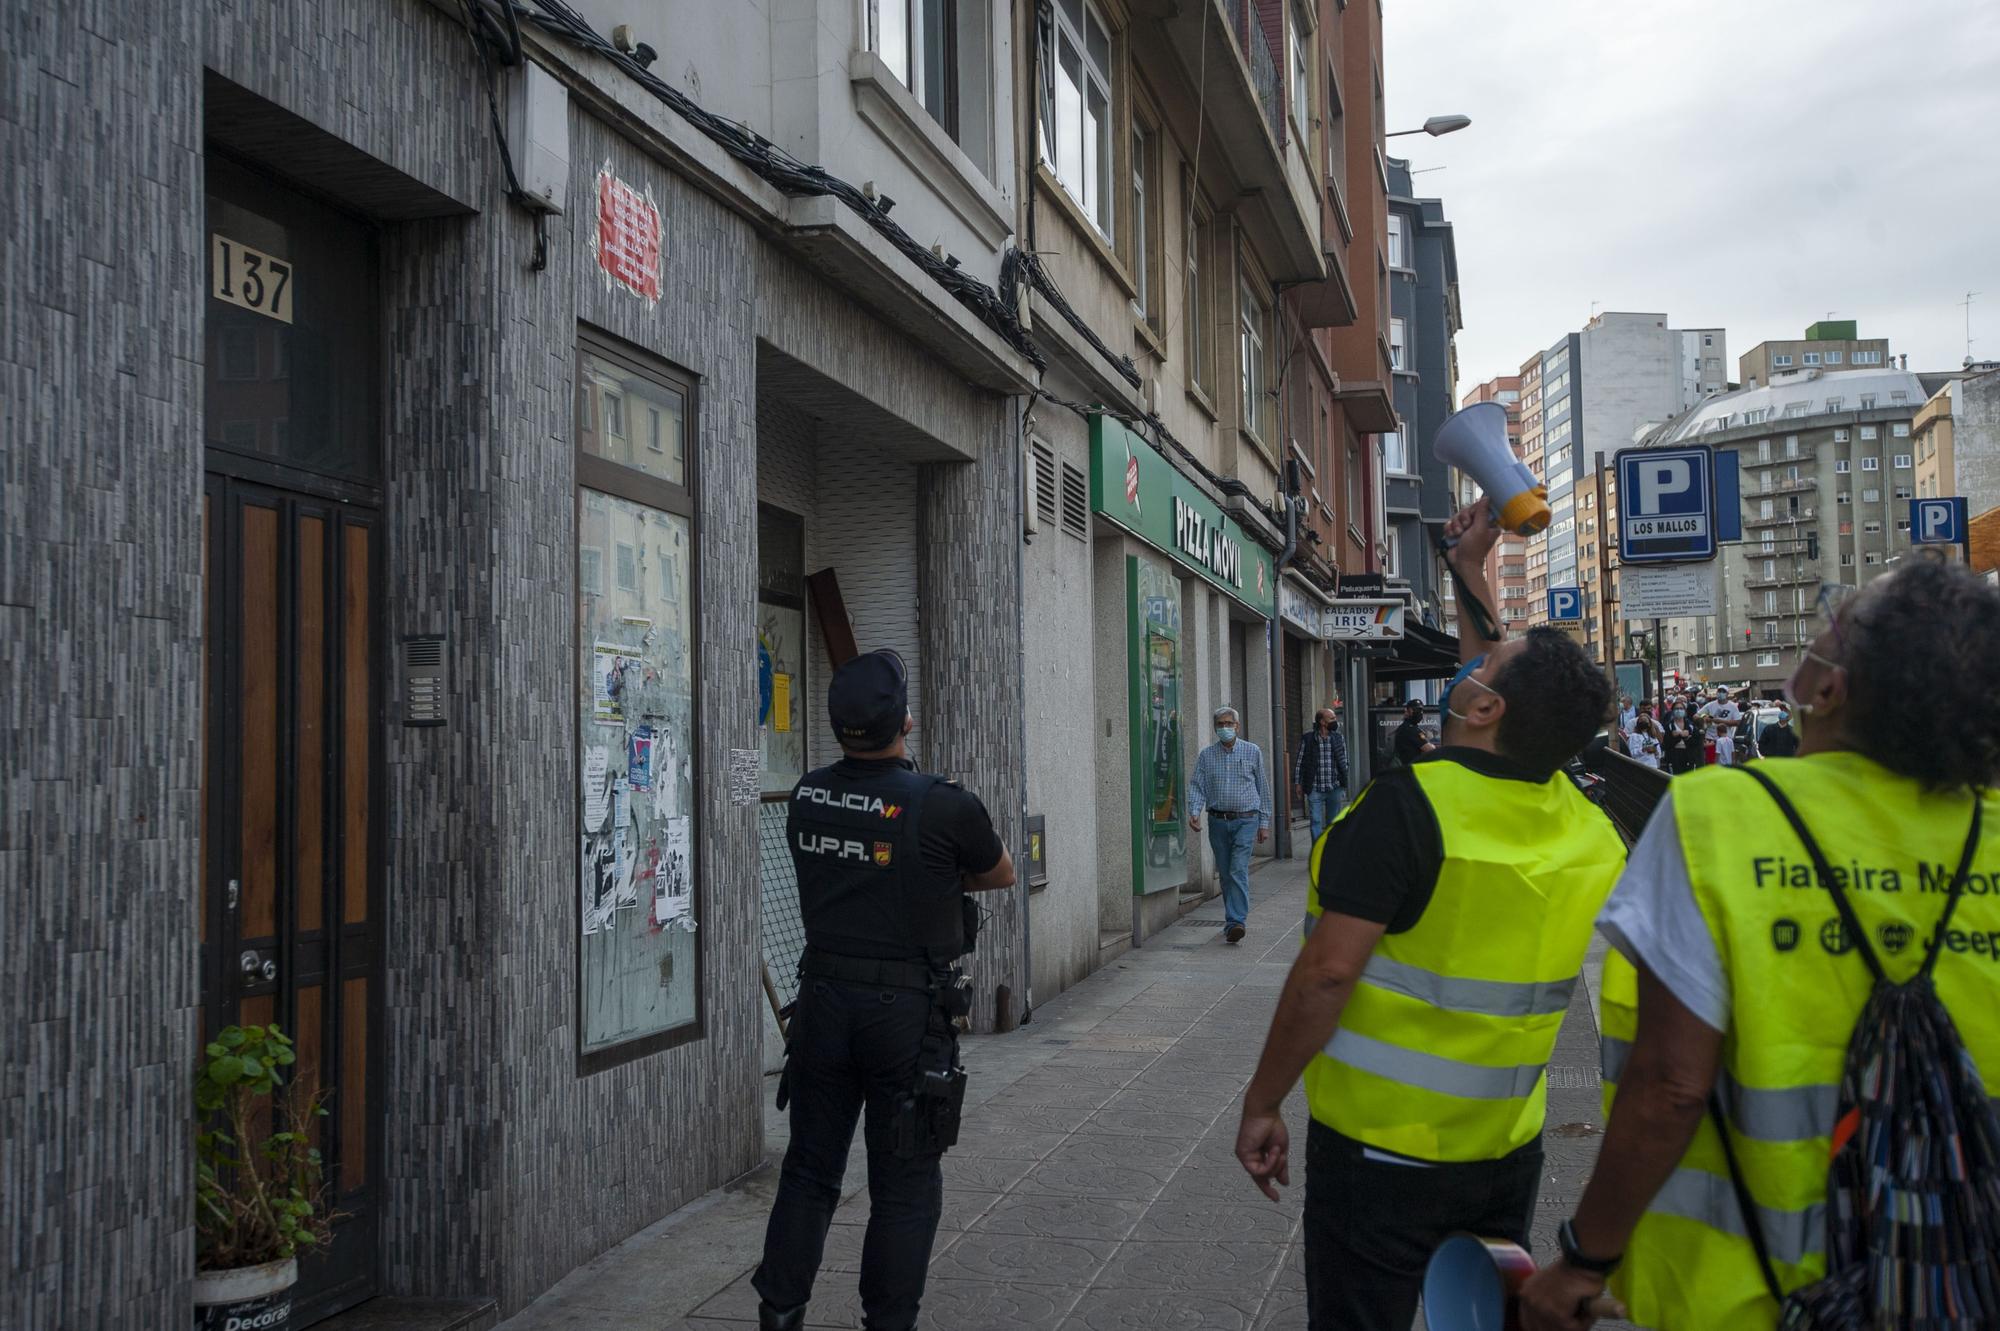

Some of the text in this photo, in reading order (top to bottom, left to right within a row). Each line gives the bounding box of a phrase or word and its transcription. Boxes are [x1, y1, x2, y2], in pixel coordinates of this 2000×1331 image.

[220, 240, 289, 314] 137
[1638, 459, 1690, 515] P
[1175, 496, 1211, 568] PIZZA
[1634, 519, 1698, 535] LOS MALLOS
[1925, 505, 1948, 537] P
[1324, 606, 1375, 615] CALZADOS
[1554, 592, 1574, 617] P
[1335, 616, 1367, 626] IRIS
[797, 786, 885, 814] POLICIA
[799, 832, 870, 861] U.P.R.
